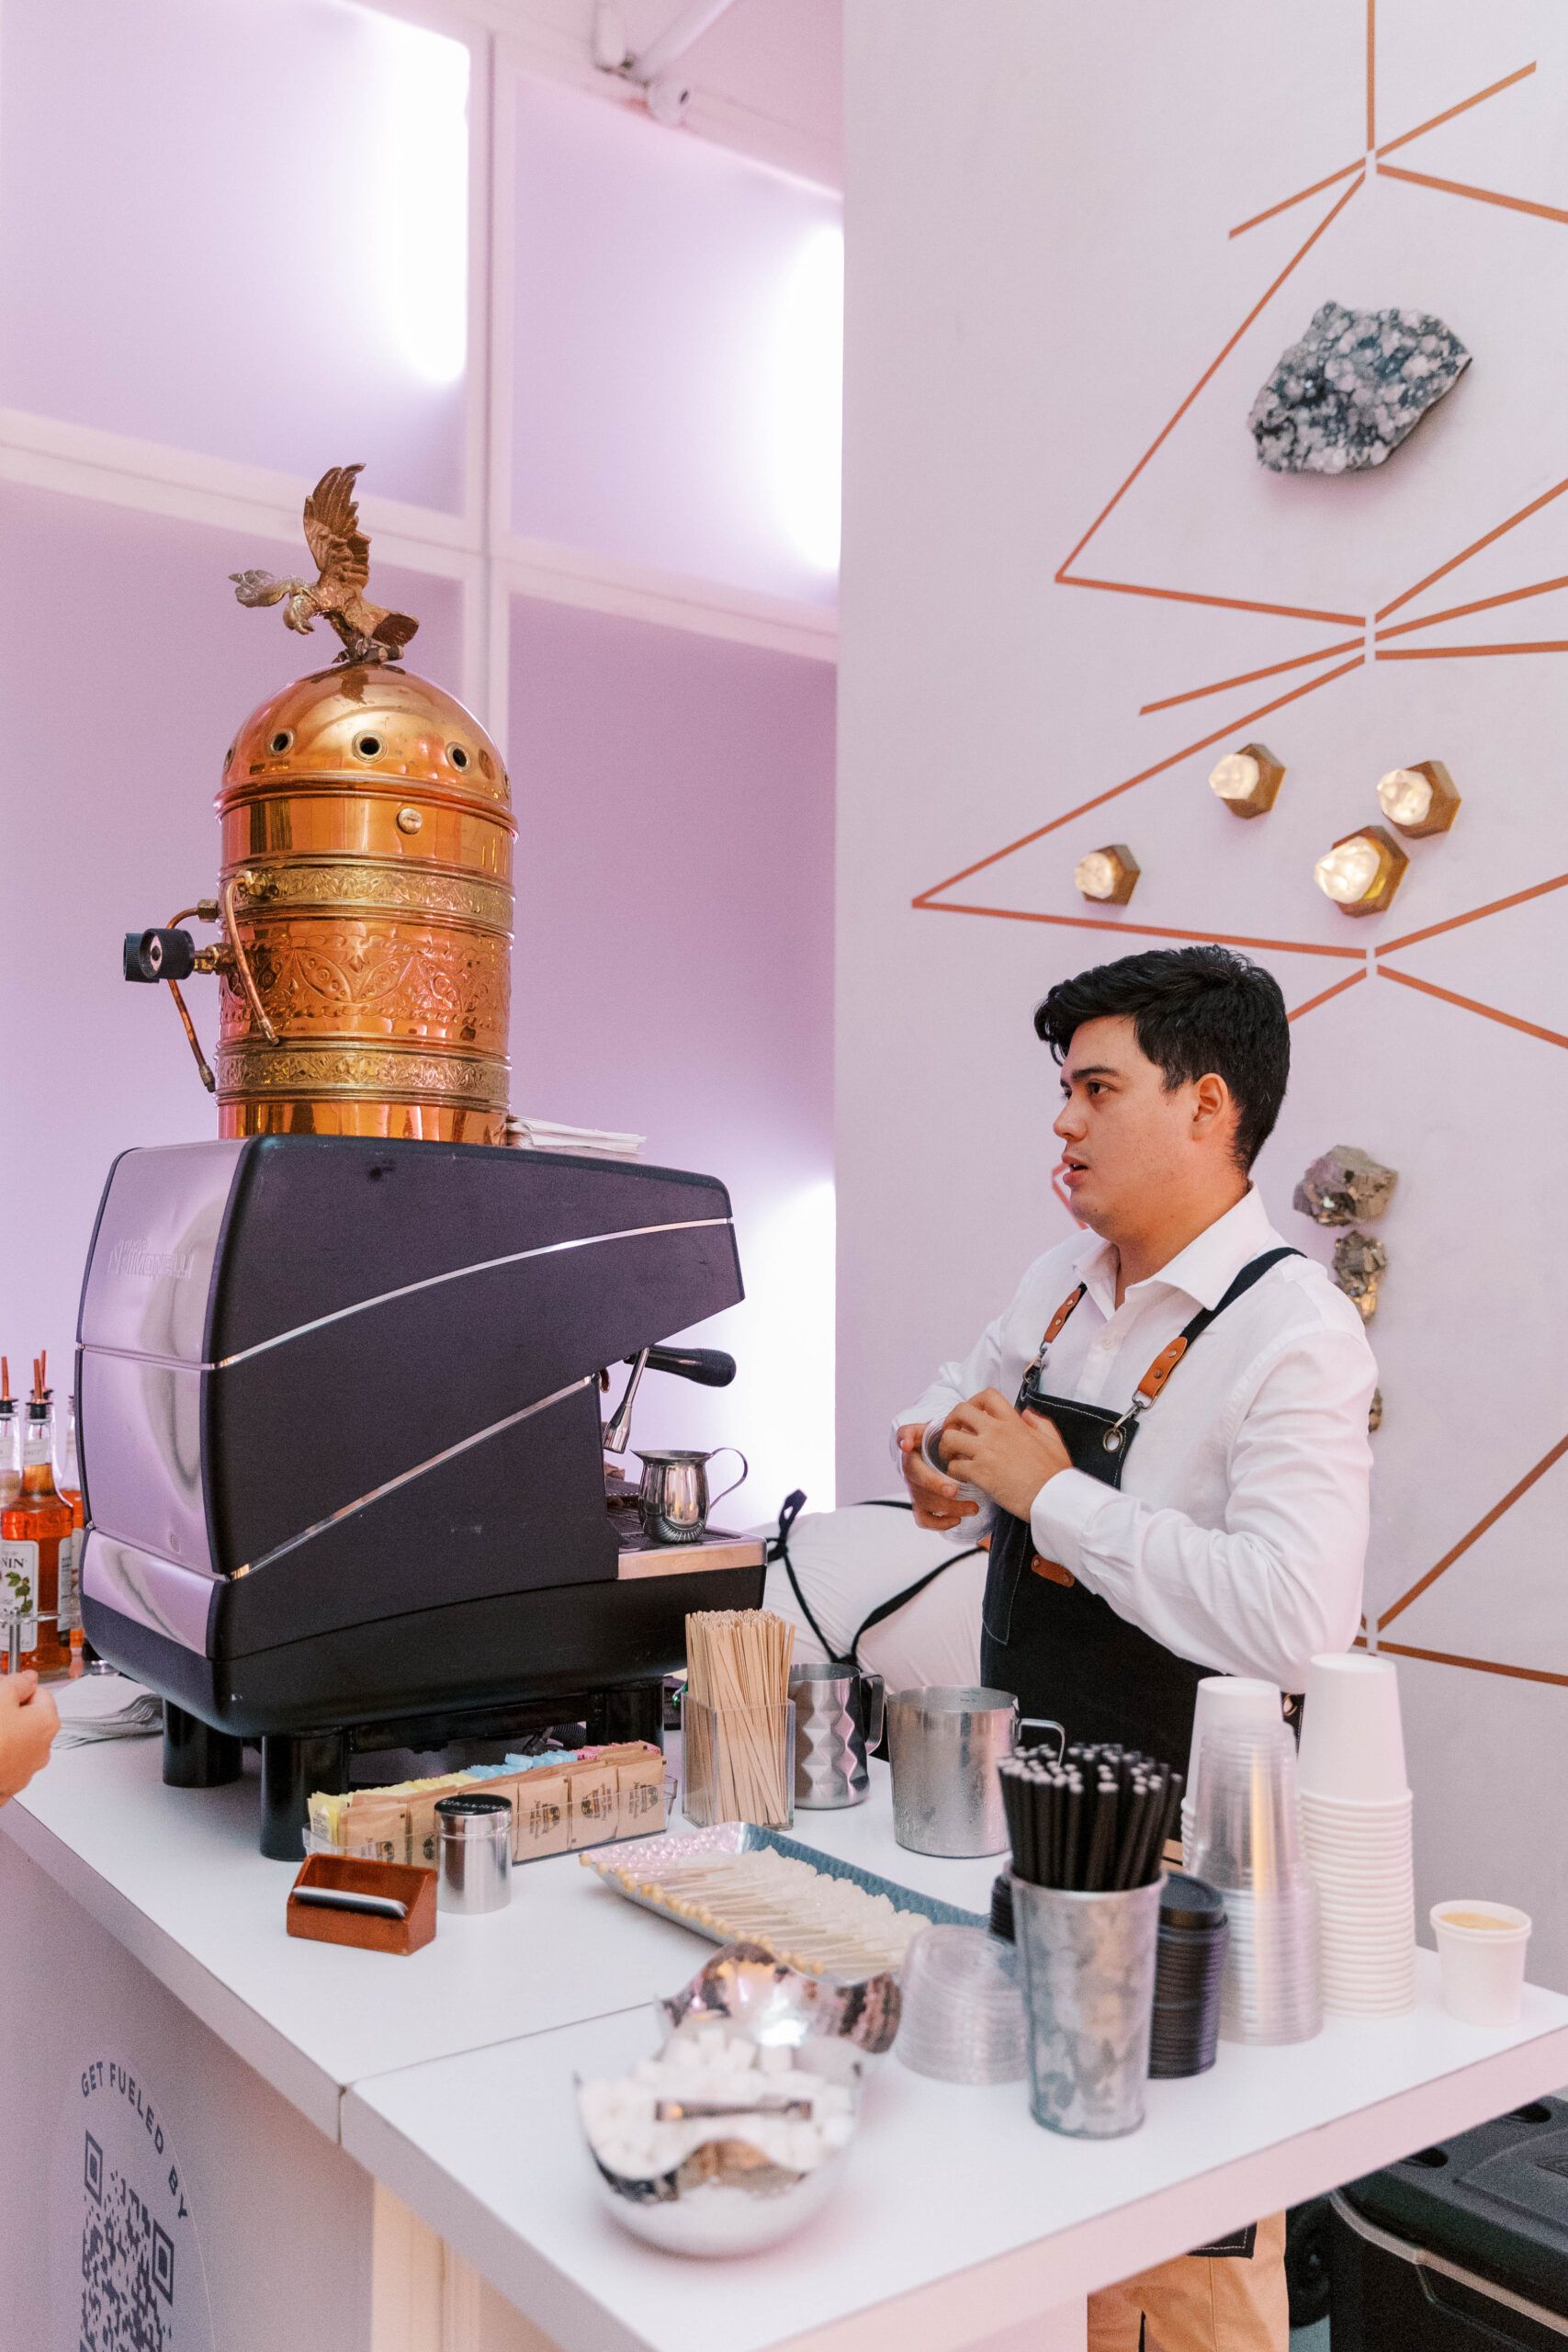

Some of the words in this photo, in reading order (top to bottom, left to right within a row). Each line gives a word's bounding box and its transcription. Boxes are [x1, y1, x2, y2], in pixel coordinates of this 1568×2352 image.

[81, 2061, 103, 2098] GET
[109, 2062, 164, 2154] FUELED
[168, 2165, 187, 2220] BY
